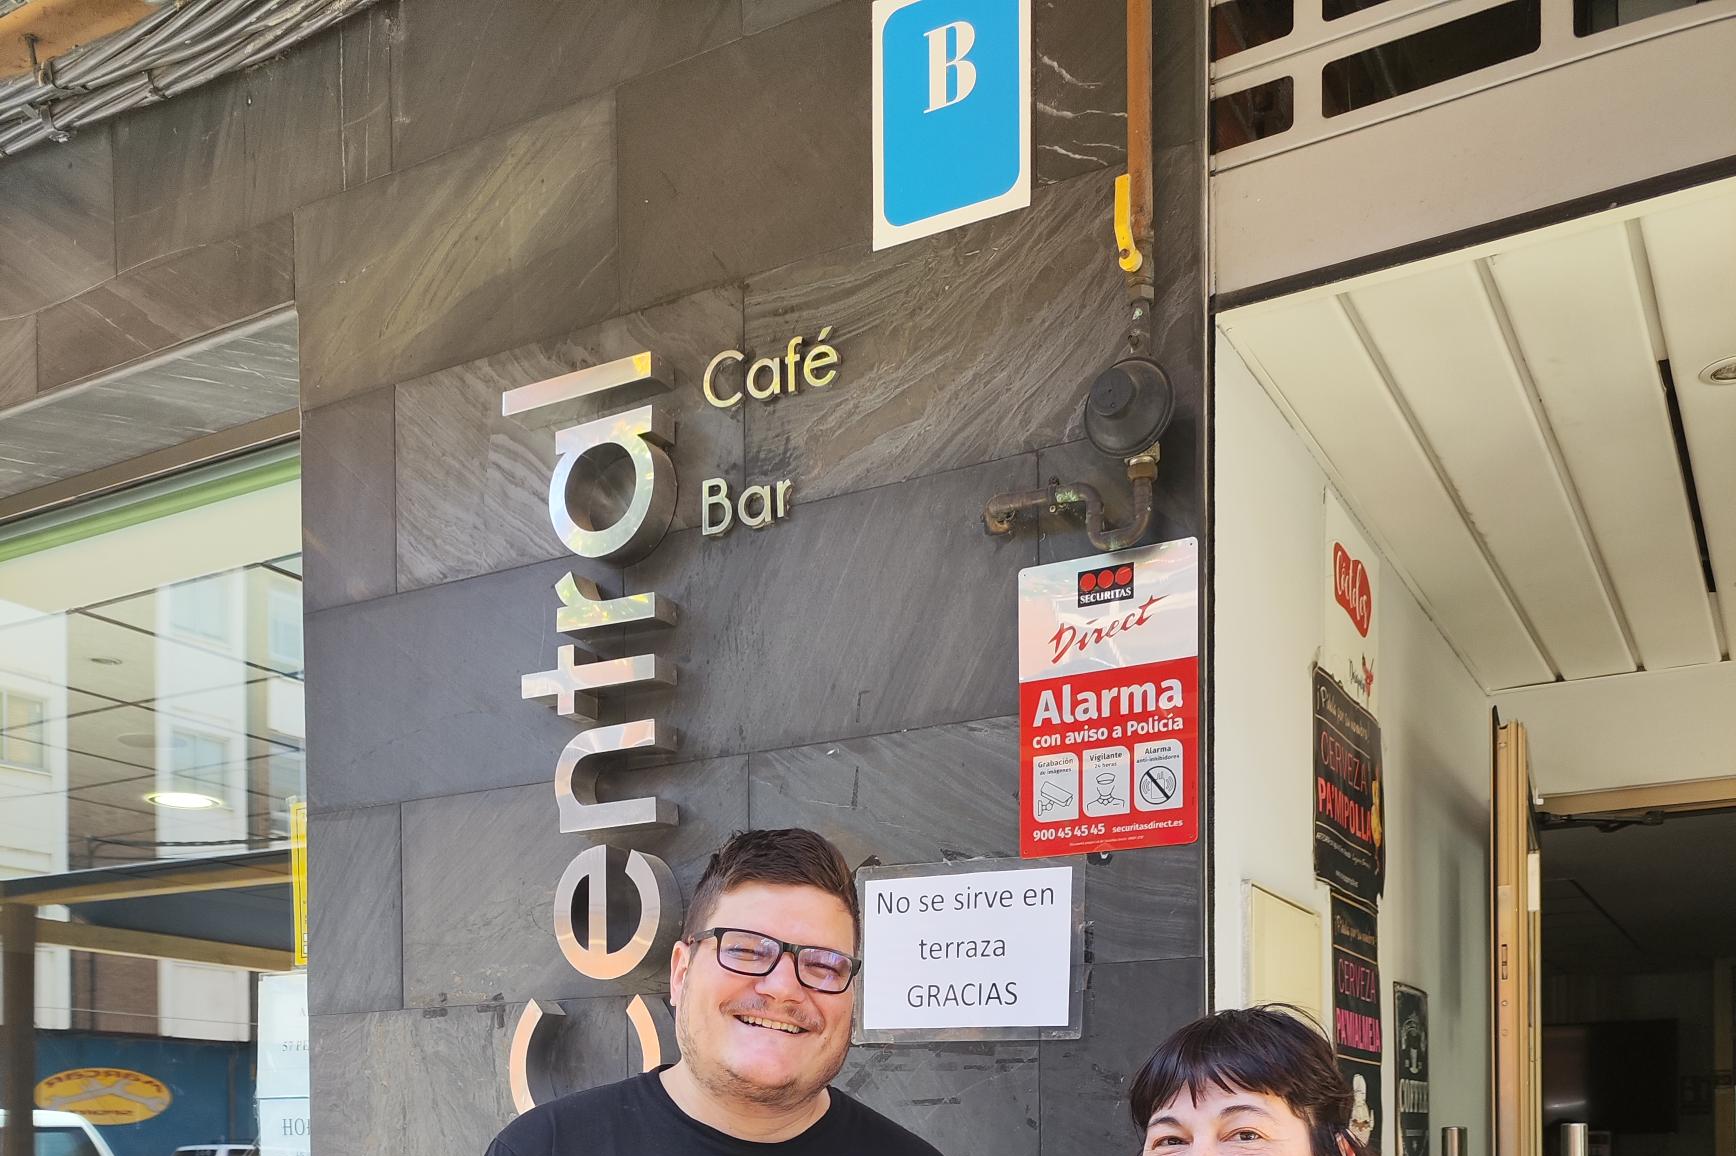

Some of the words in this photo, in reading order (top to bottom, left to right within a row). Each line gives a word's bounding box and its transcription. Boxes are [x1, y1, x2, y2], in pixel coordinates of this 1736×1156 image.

[923, 20, 977, 114] B
[703, 326, 840, 408] Café
[702, 477, 793, 537] Bar
[1079, 586, 1132, 605] SECURITAS
[1048, 593, 1170, 665] Direct
[1032, 677, 1184, 728] Alarma
[1032, 731, 1061, 750] con
[1065, 725, 1106, 746] aviso
[1111, 725, 1122, 739] a
[1127, 713, 1184, 737] Policía
[1037, 757, 1074, 769] Grabación
[1089, 751, 1123, 763] Vigilante
[1144, 745, 1172, 755] Alarma
[1320, 730, 1369, 796] CERVEZA
[1033, 828, 1056, 842] 900
[1057, 826, 1072, 839] 45
[1074, 824, 1089, 837] 45
[1090, 822, 1105, 836] 45
[1112, 818, 1184, 834] securitasdirect.es
[876, 891, 911, 915] No
[918, 892, 945, 913] se
[953, 886, 1013, 911] sirve
[1023, 886, 1055, 907] en
[918, 938, 1006, 960] terraza
[906, 981, 1018, 1008] GRACIAS
[1337, 958, 1377, 1003] CERVEZA
